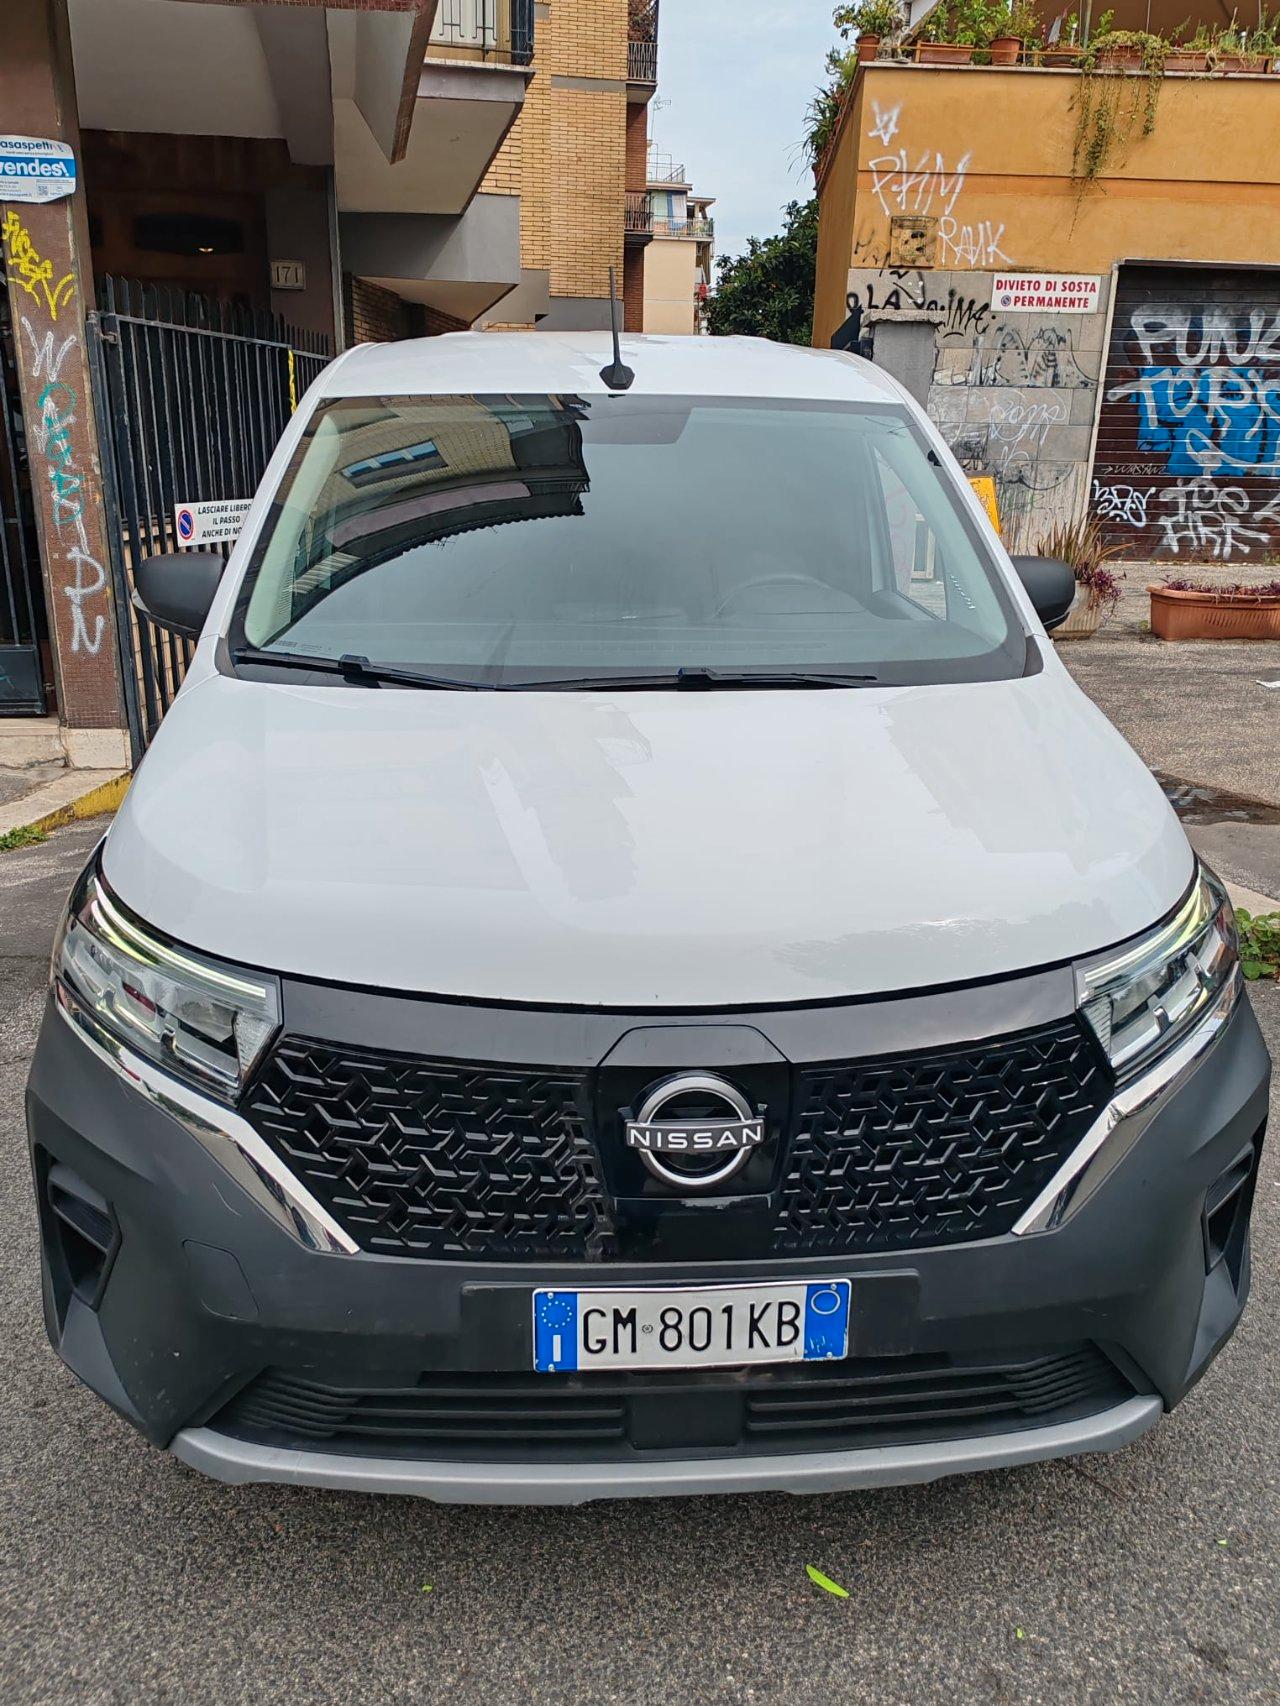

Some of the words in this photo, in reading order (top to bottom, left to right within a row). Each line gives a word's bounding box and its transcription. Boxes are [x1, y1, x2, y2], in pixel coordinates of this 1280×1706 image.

[276, 265, 299, 283] 171
[996, 279, 1040, 291] DIVIETO
[1045, 280, 1057, 291] DI
[1061, 281, 1096, 293] SOSTA
[1013, 296, 1089, 308] PERMANENTE
[198, 504, 228, 514] LASCIARE
[230, 503, 252, 512] LIBERO
[220, 516, 240, 524] PASSO
[202, 528, 223, 538] ANCHE
[224, 527, 231, 536] DI
[630, 1125, 764, 1149] NISSAN
